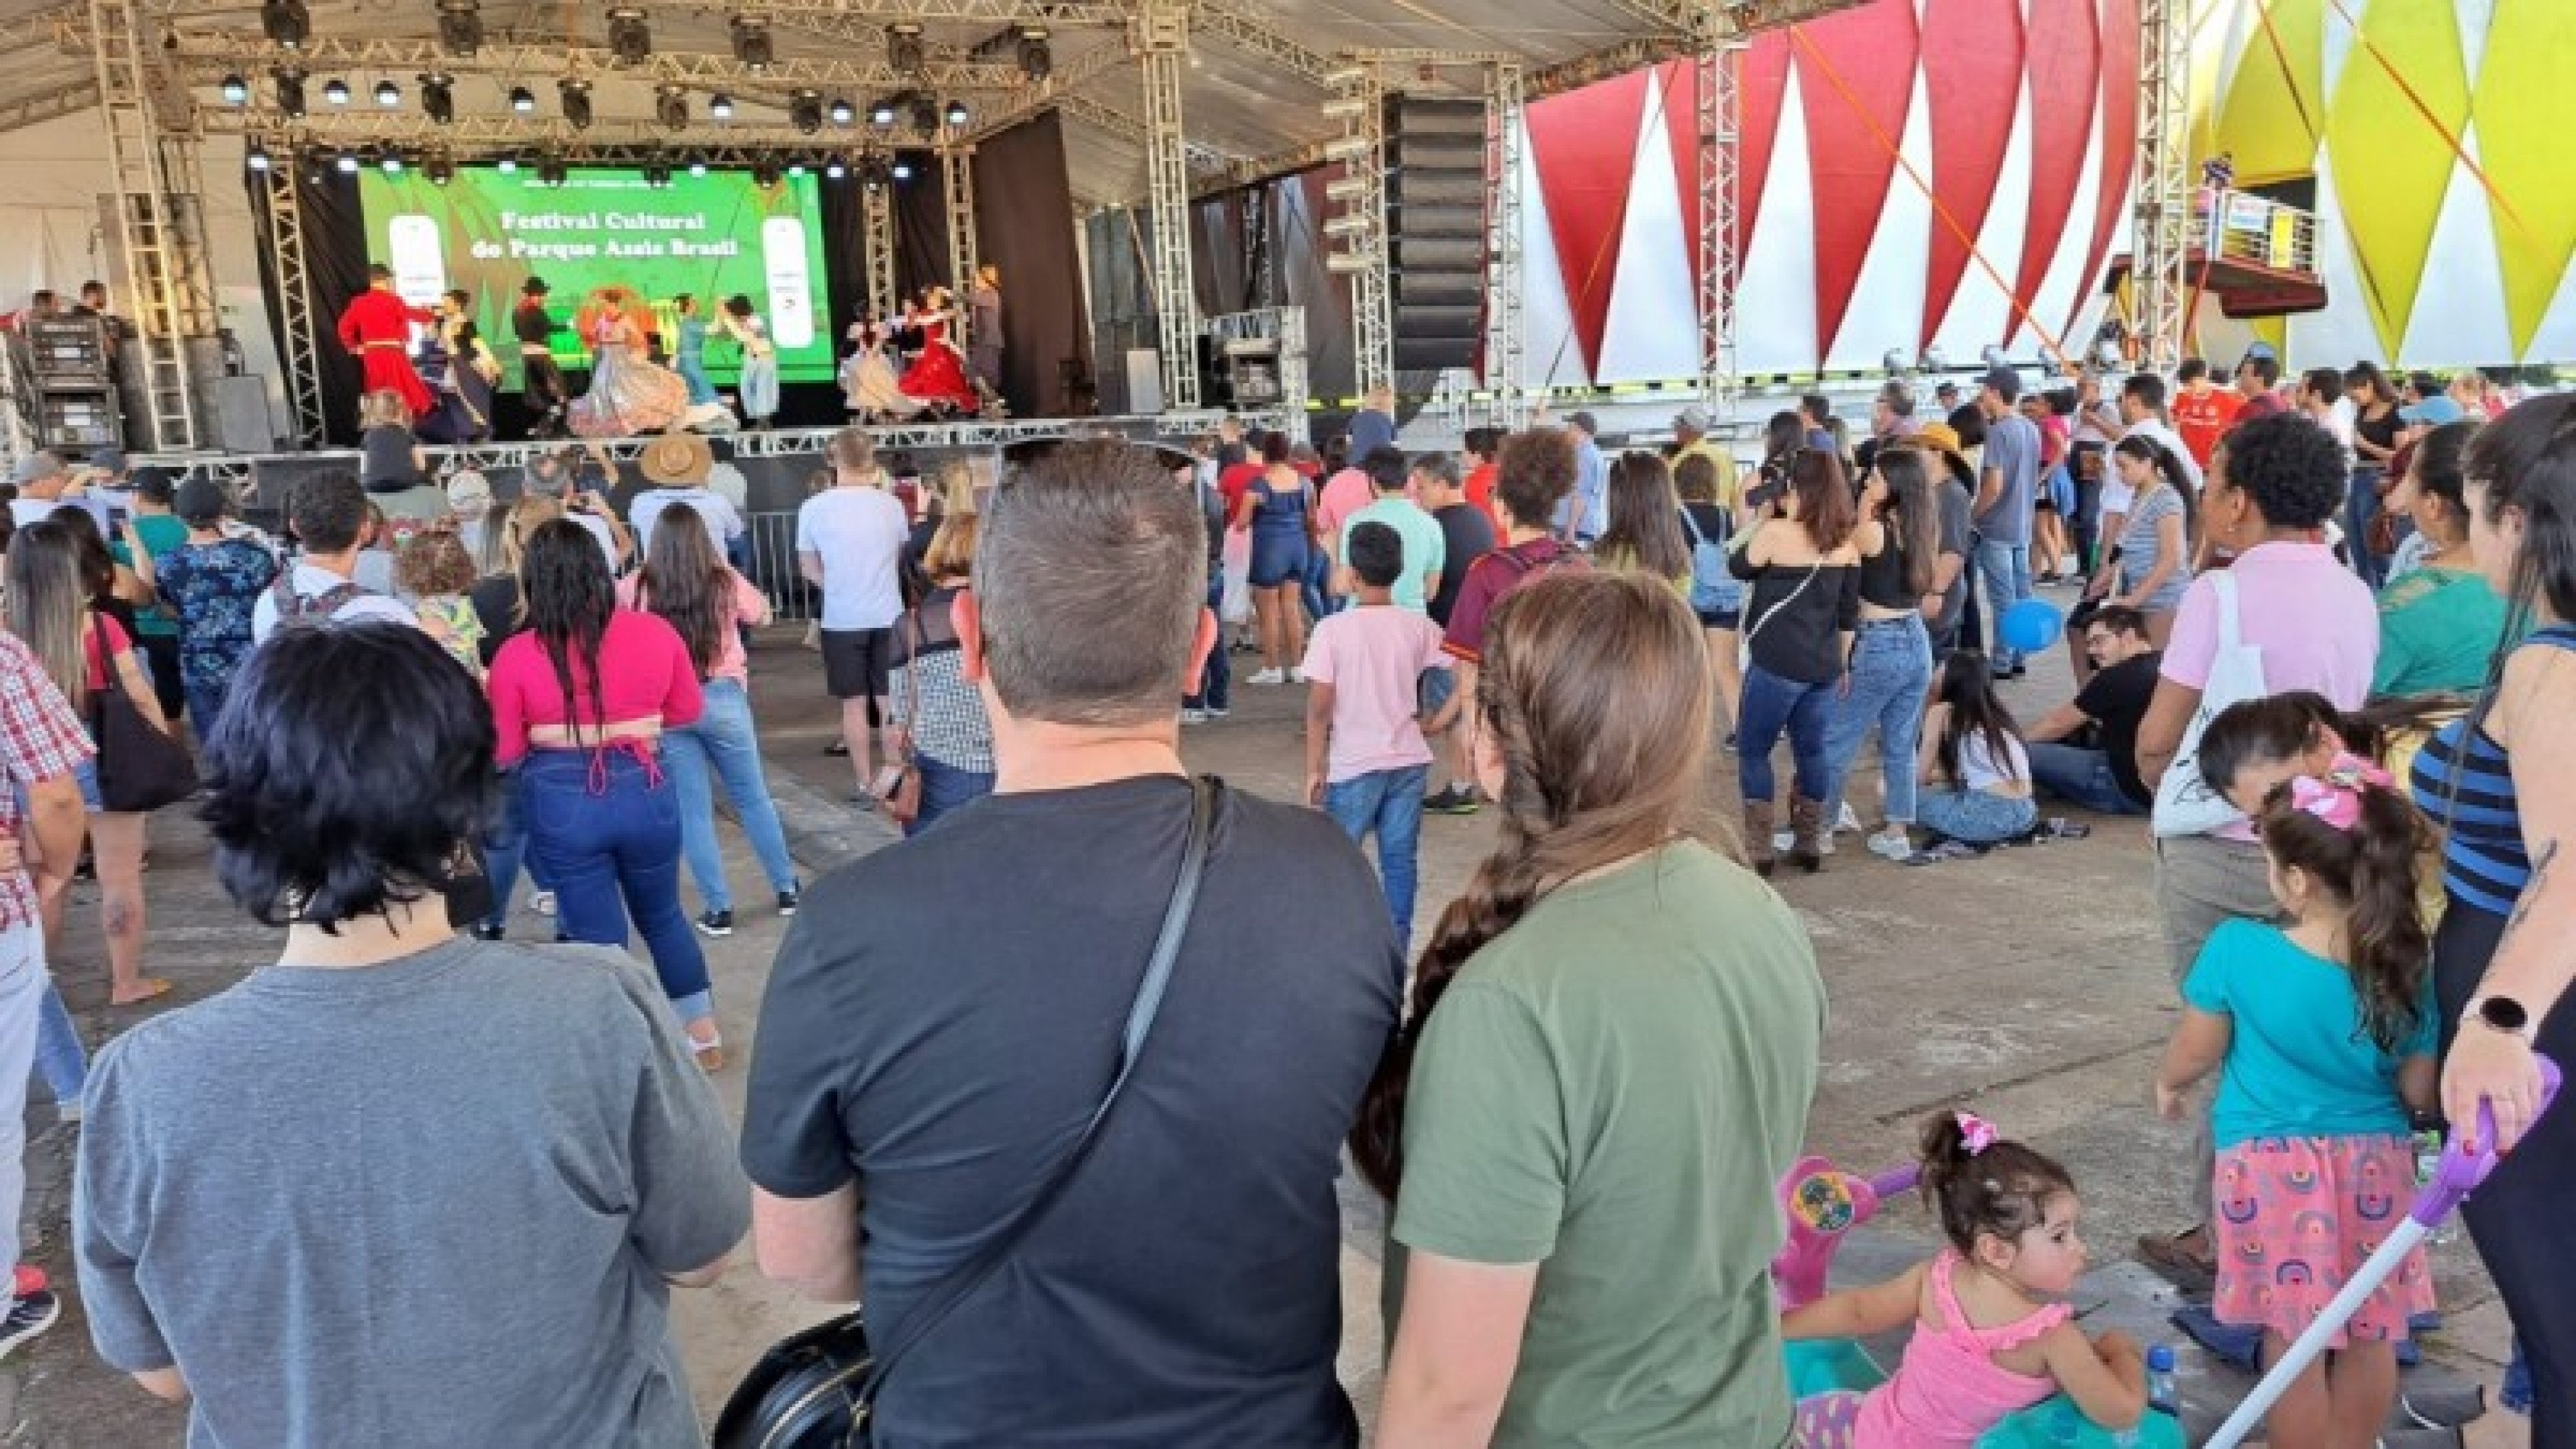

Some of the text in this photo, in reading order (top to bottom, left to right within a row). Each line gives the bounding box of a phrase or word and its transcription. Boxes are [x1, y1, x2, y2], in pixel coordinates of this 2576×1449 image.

[501, 213, 706, 229] Festival Cultural
[471, 238, 738, 260] do Parque Assis Brasil
